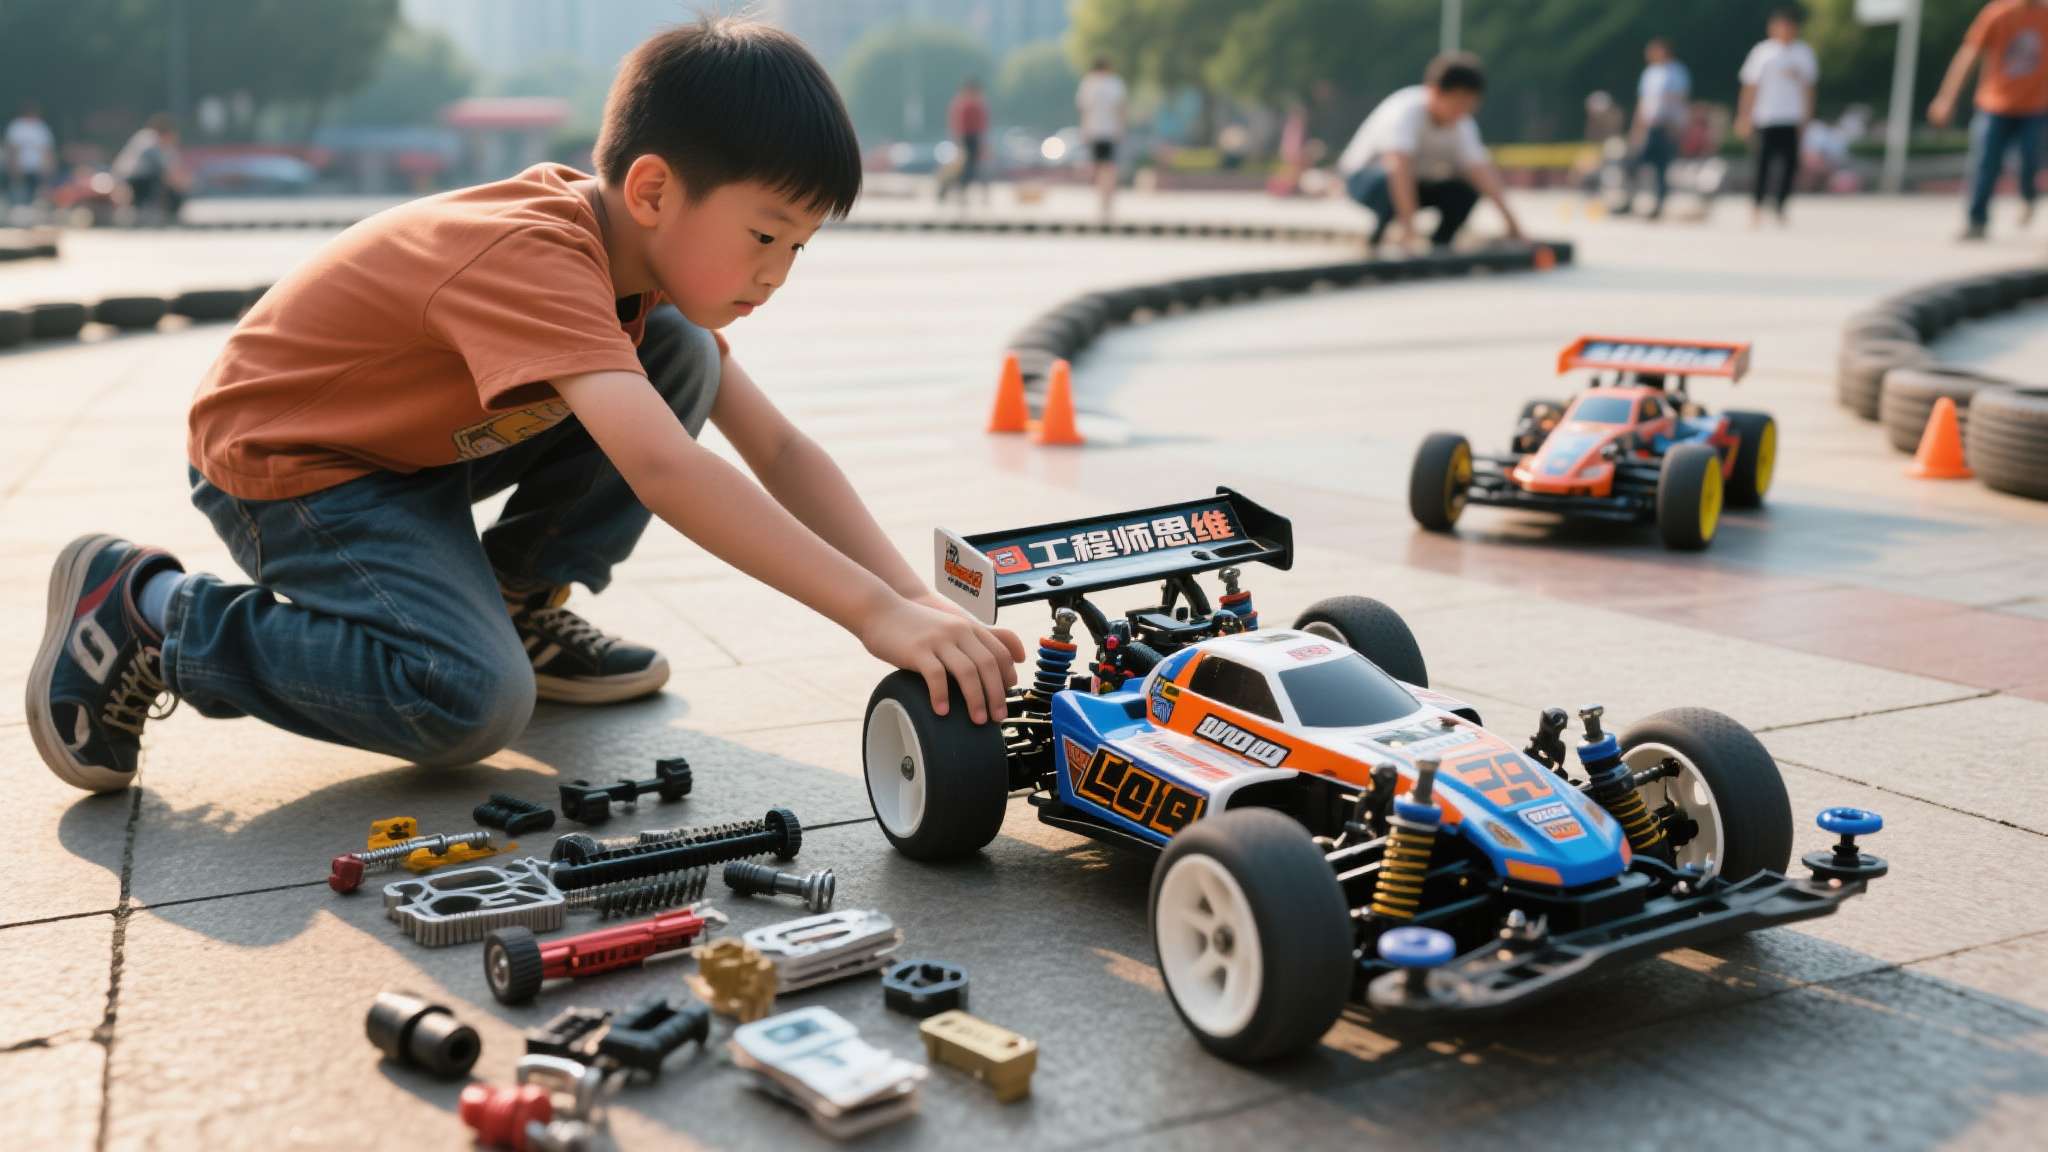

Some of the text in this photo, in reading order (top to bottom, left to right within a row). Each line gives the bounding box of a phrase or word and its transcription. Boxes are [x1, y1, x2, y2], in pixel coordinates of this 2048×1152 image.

[1028, 509, 1235, 568] 工程师思维
